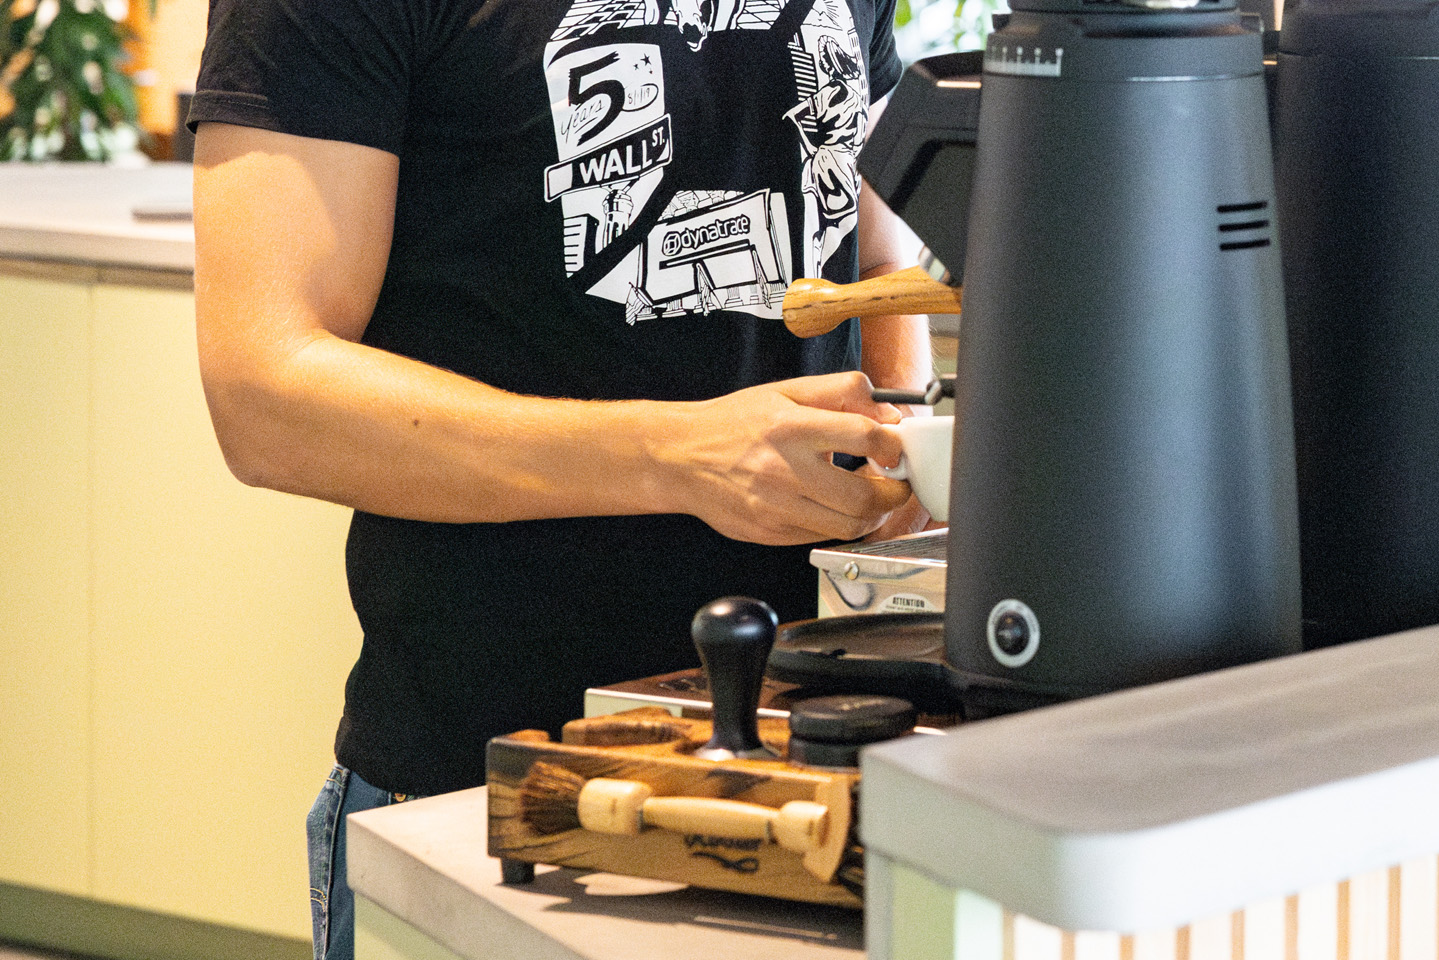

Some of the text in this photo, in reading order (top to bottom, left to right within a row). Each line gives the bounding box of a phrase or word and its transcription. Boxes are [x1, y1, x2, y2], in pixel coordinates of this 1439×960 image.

[568, 50, 625, 147] 5
[580, 139, 653, 184] WALL
[681, 215, 750, 250] dynatrace
